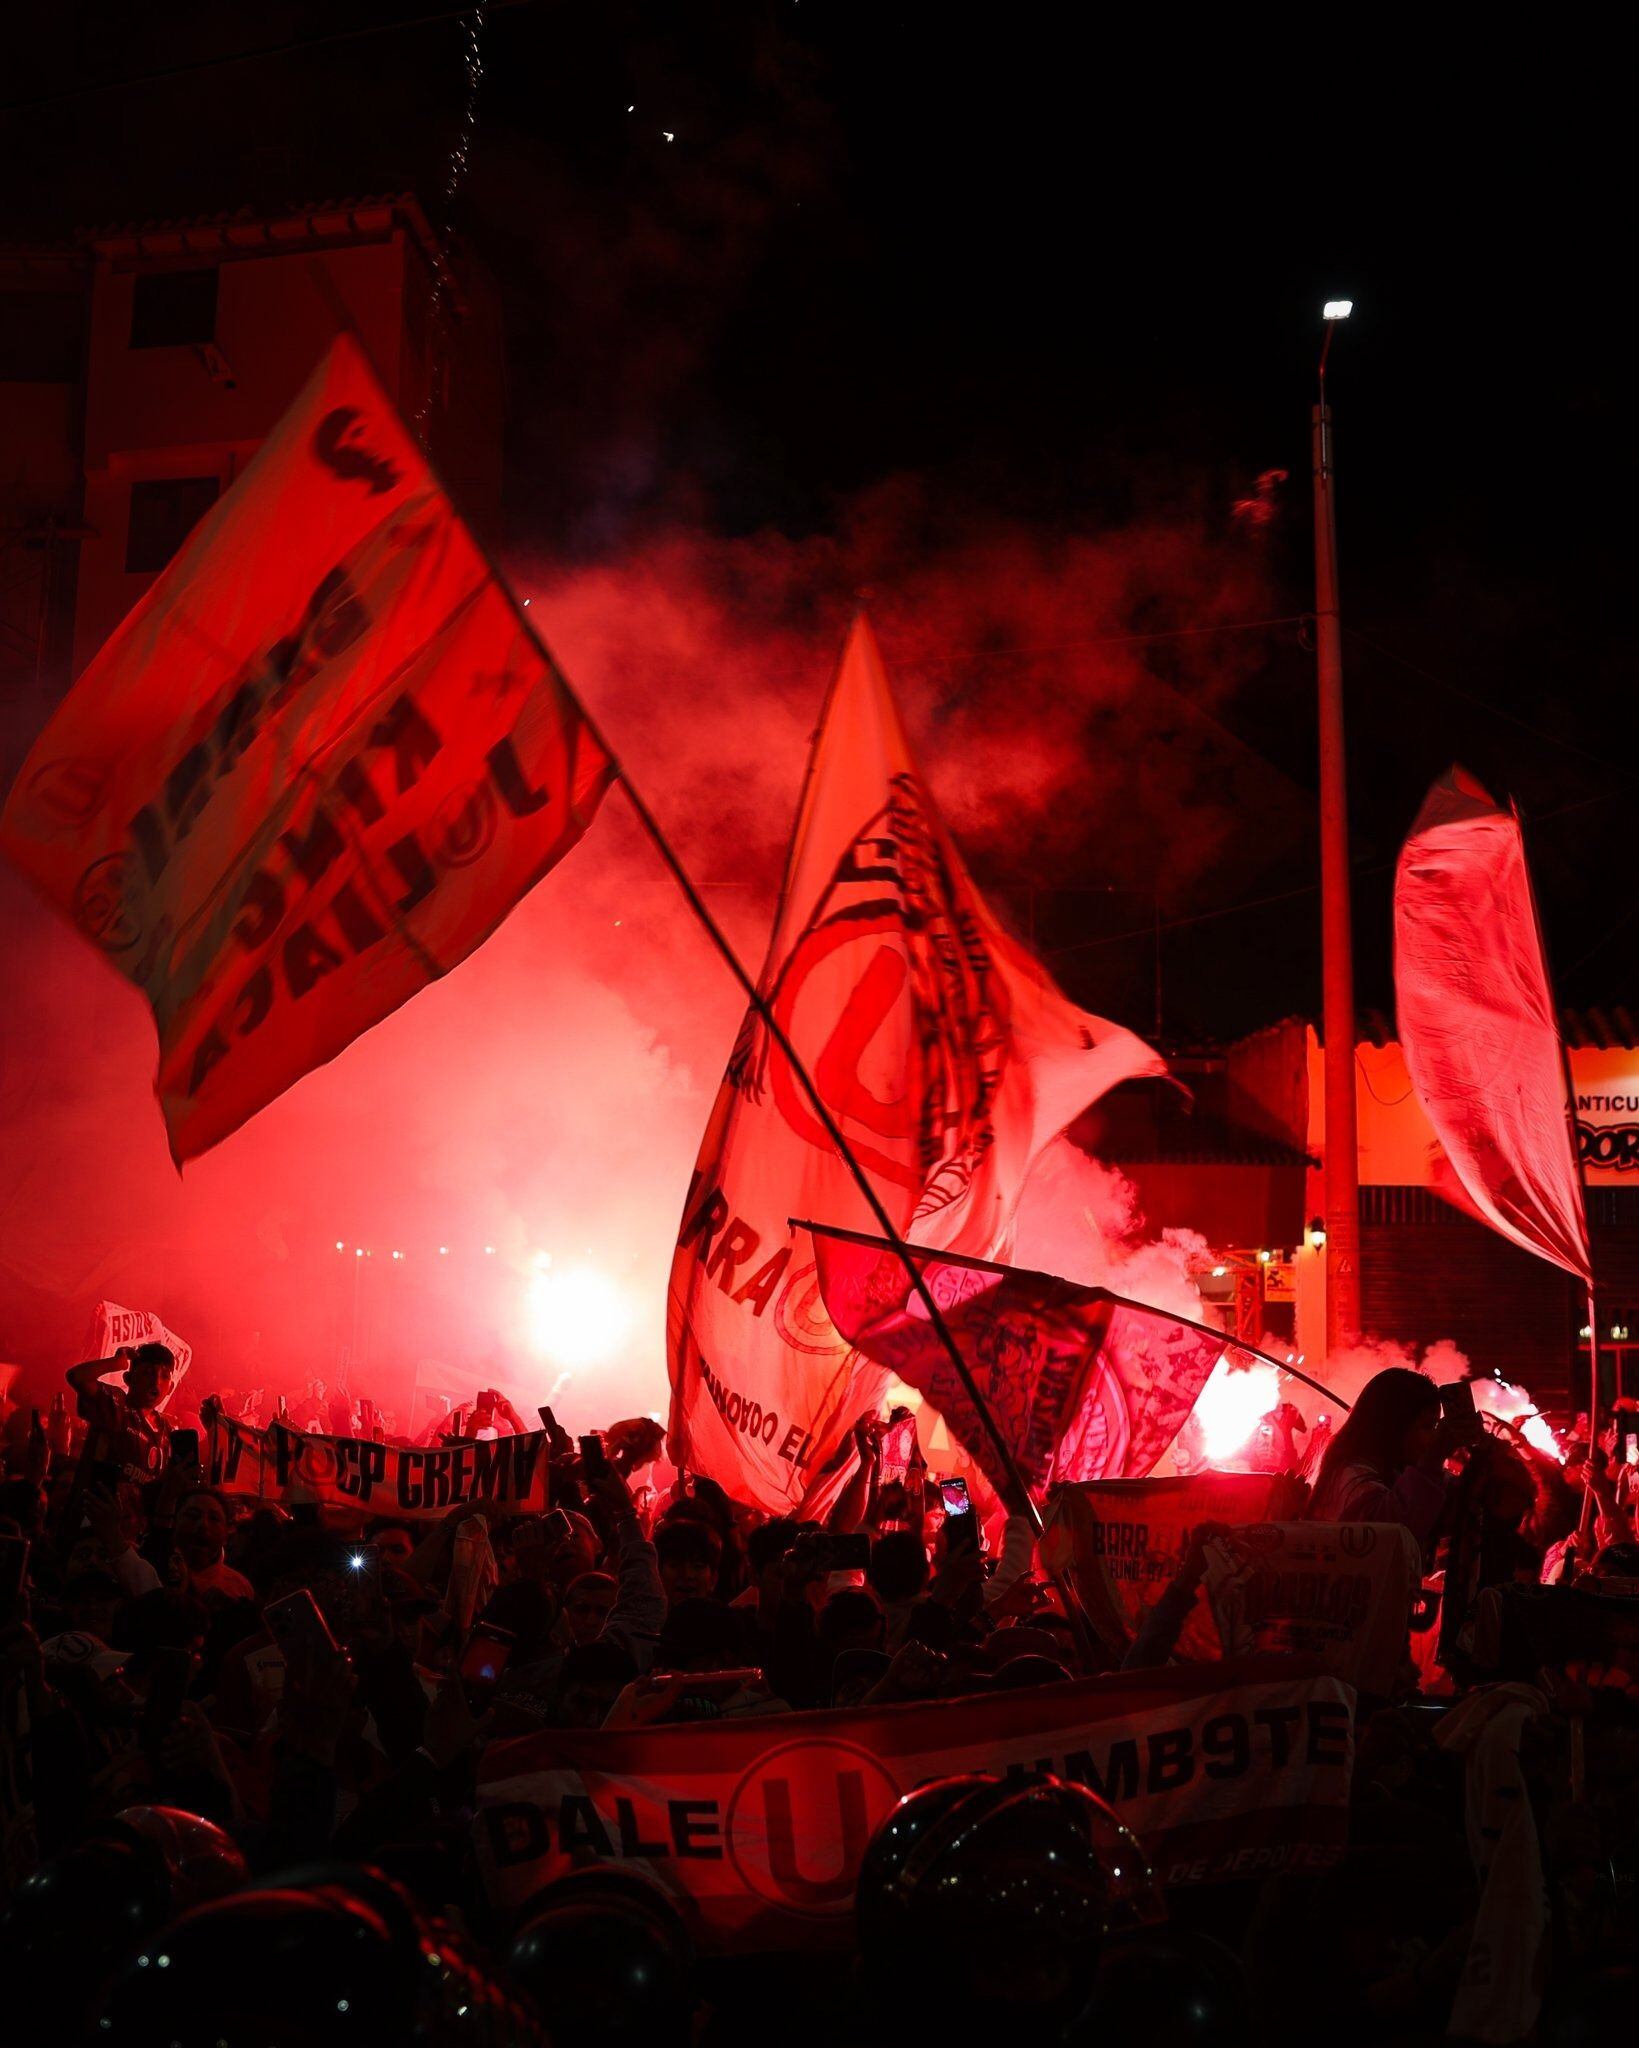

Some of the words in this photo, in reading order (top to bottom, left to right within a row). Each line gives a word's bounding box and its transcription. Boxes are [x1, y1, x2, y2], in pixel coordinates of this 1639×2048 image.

[677, 1169, 793, 1317] RRA
[485, 1796, 724, 1867] DALE
[762, 1769, 870, 1903] U
[968, 1700, 1349, 1804] MB9TE
